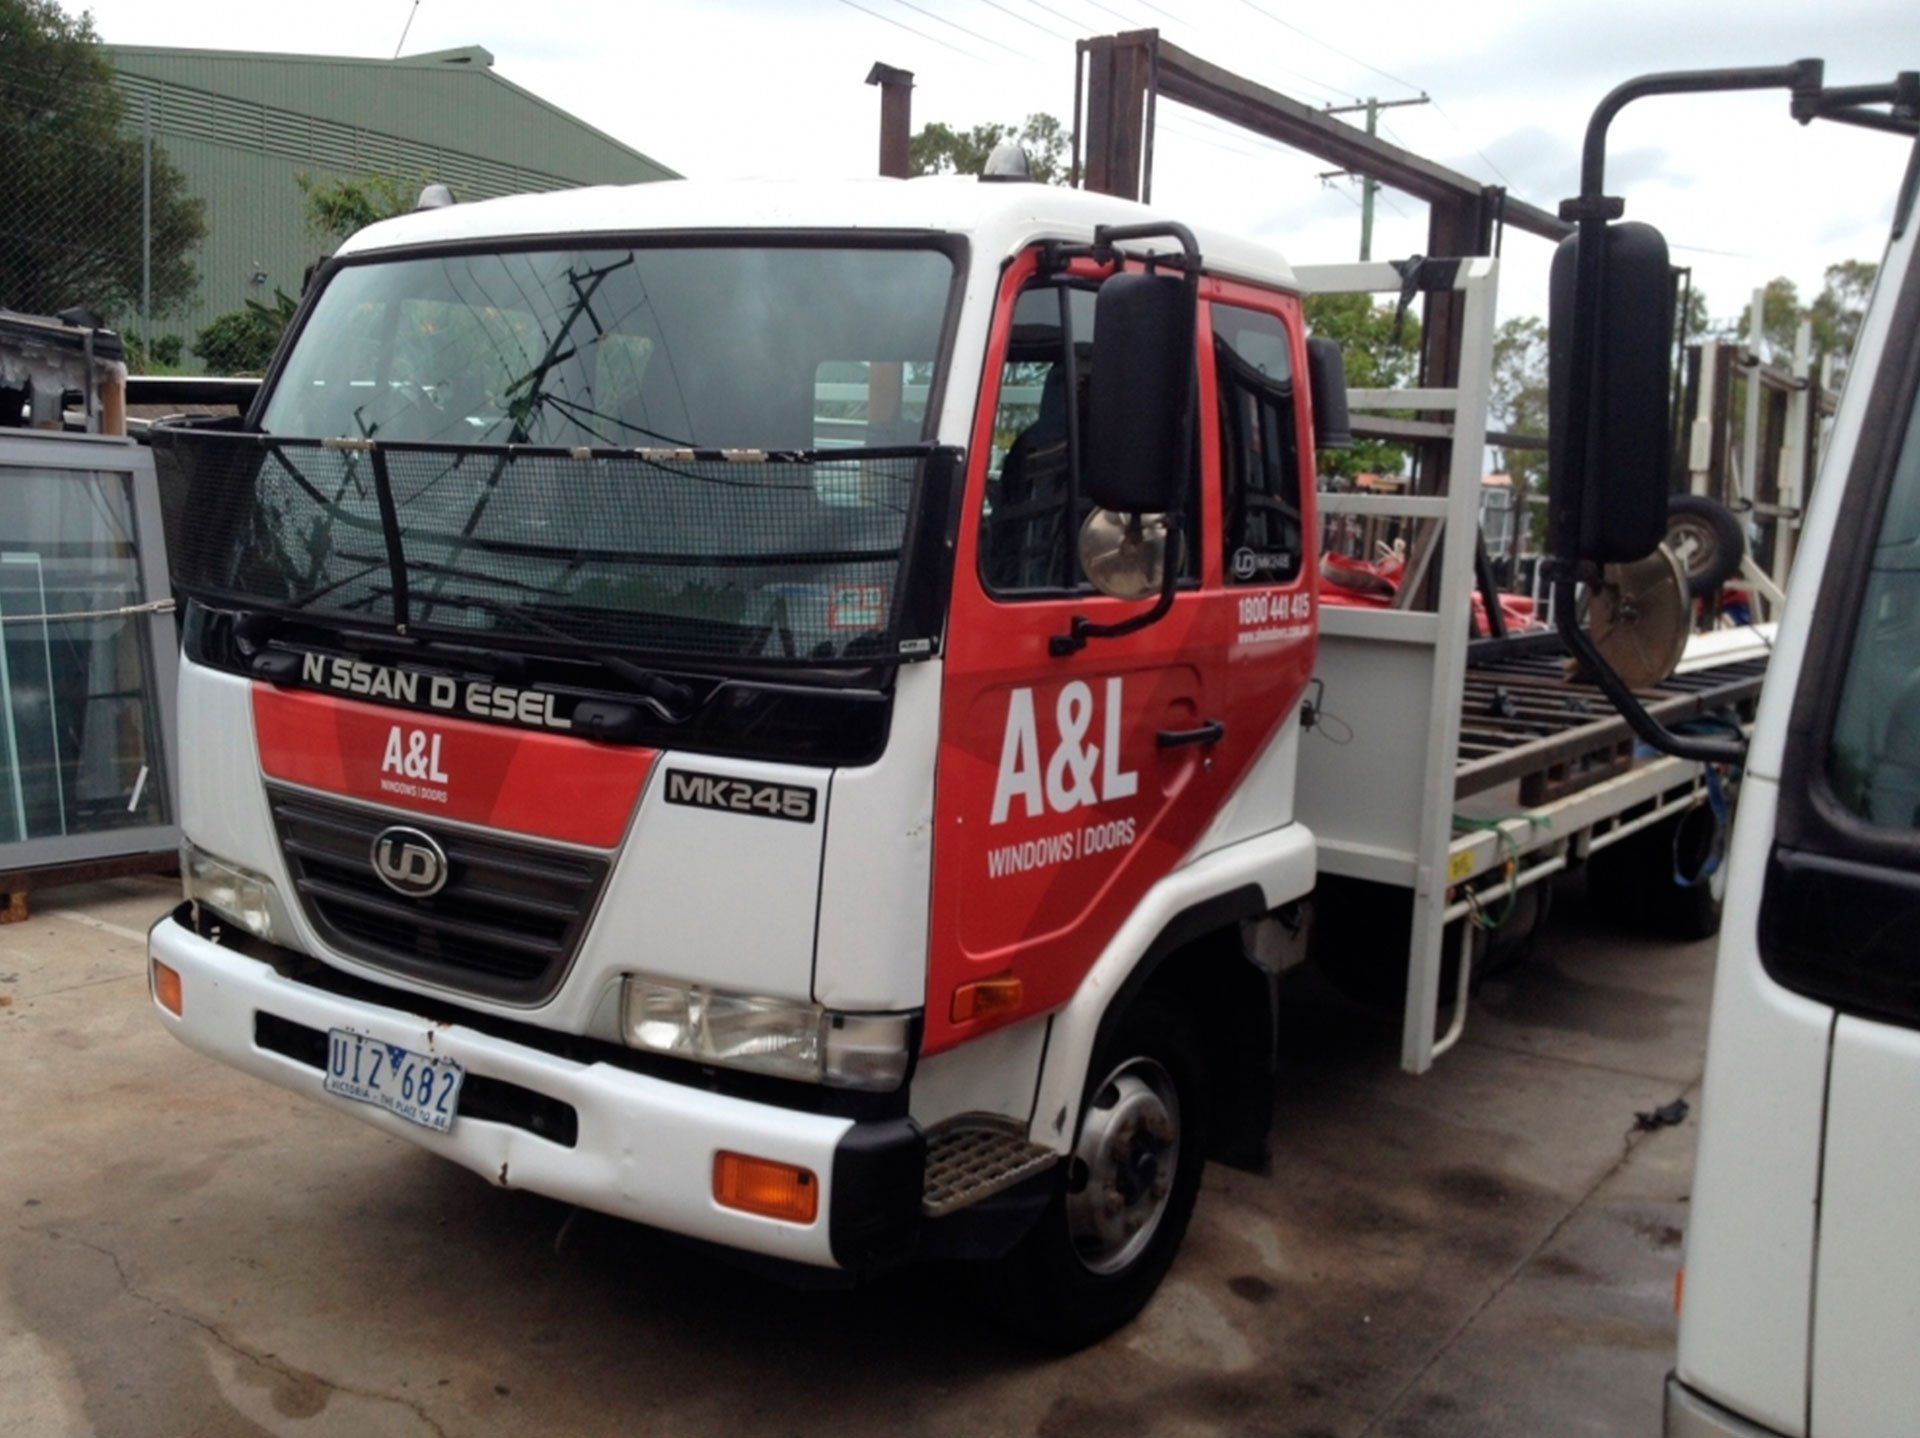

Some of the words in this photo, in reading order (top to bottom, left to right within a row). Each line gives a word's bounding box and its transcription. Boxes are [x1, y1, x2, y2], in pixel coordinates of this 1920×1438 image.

[1239, 596, 1268, 625] 1800
[1270, 594, 1289, 621] 441
[1291, 592, 1310, 618] 415
[381, 725, 449, 784] A&L
[990, 677, 1139, 826] A&L
[381, 779, 417, 797] WINDOWS
[421, 787, 448, 804] DOORS
[670, 773, 811, 818] MK245
[379, 838, 437, 885] UD
[988, 834, 1074, 879] WINDOWS
[1084, 817, 1136, 856] DOORS
[401, 1062, 455, 1114] 682
